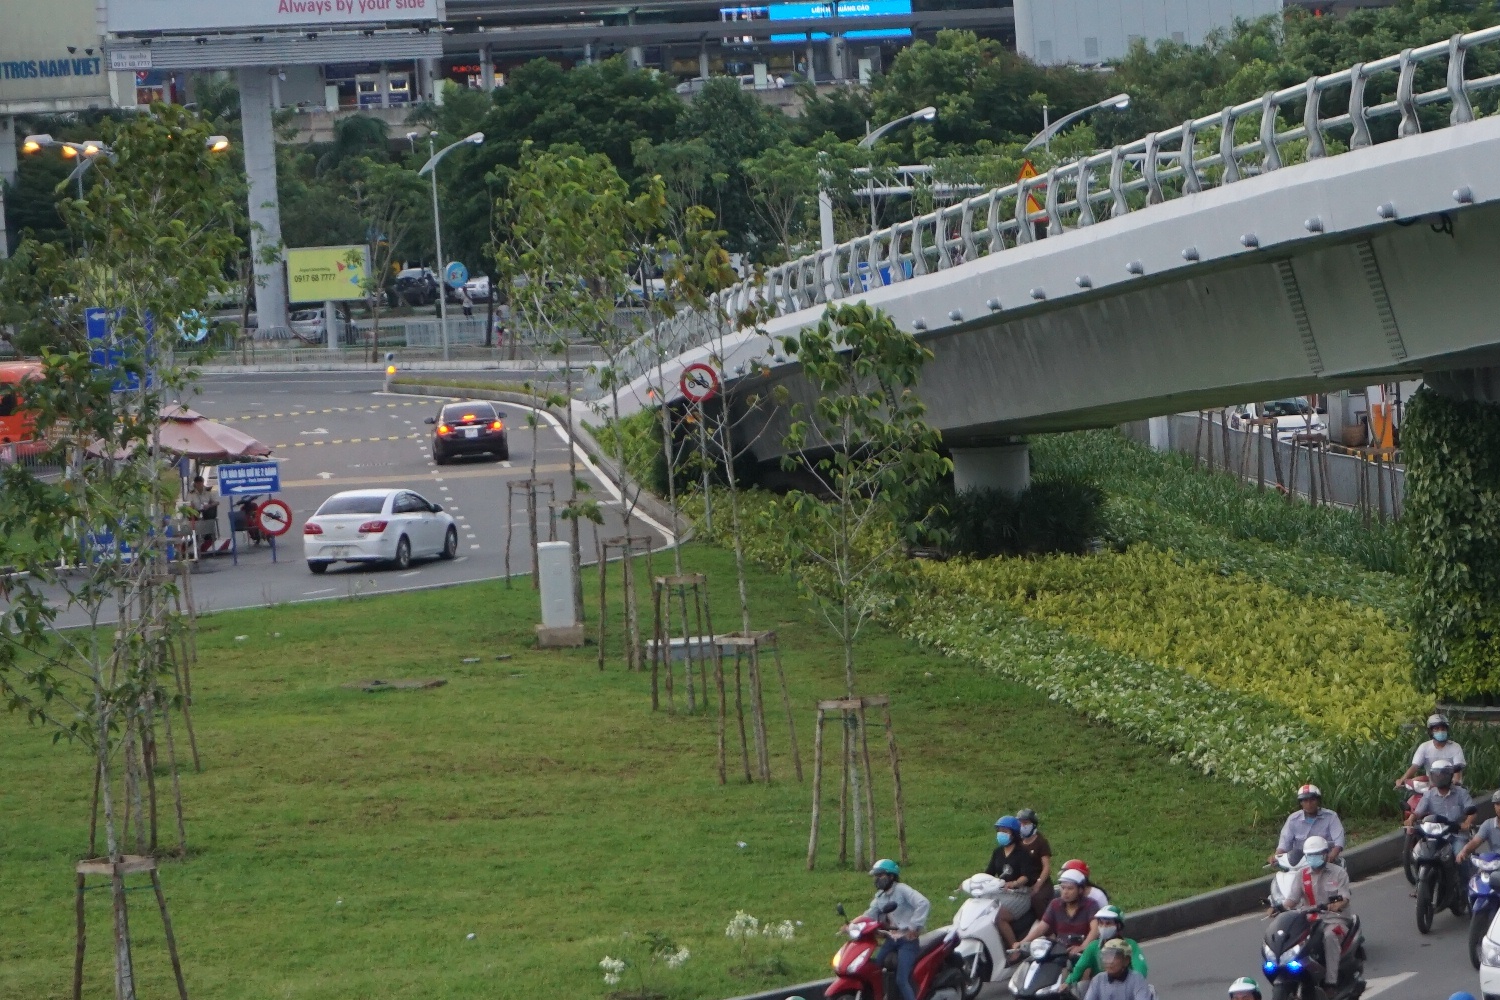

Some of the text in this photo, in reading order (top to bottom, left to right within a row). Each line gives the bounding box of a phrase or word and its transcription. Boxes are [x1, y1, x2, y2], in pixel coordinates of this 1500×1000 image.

[278, 0, 332, 15] Always
[336, 0, 352, 13] by
[358, 0, 390, 13] your
[0, 60, 38, 79] TROS
[38, 58, 70, 78] NAM
[293, 274, 310, 283] 0917
